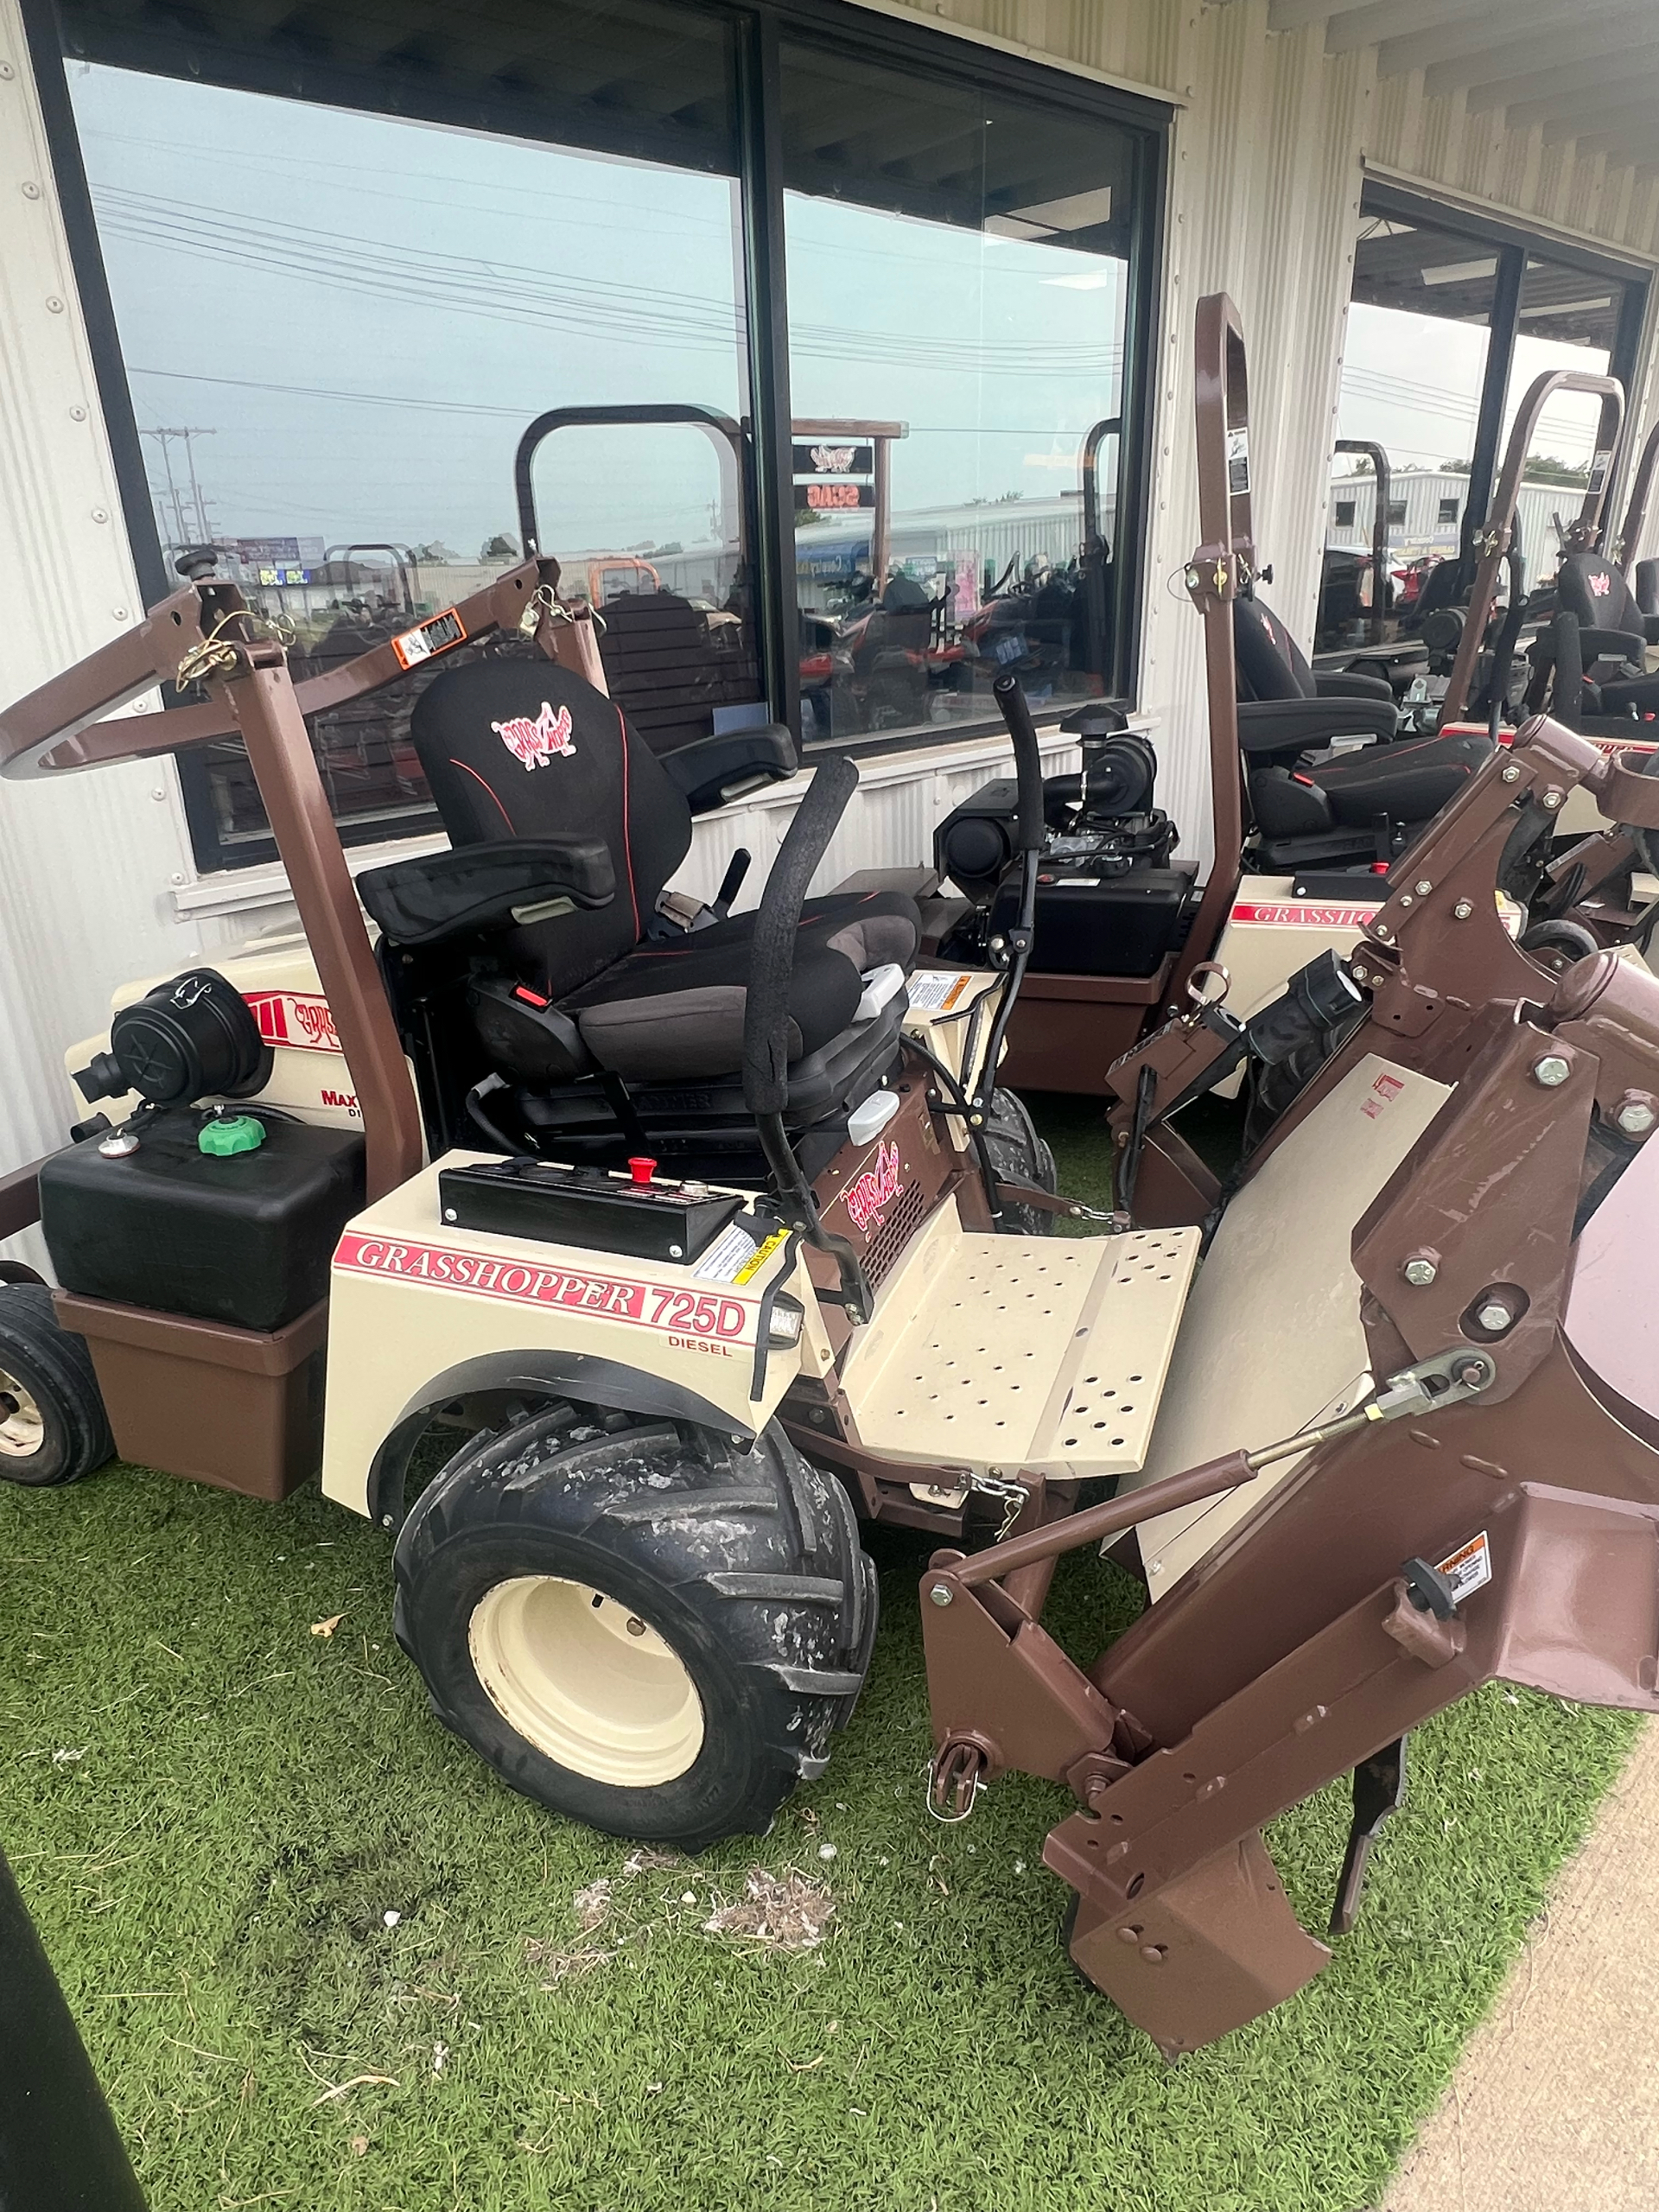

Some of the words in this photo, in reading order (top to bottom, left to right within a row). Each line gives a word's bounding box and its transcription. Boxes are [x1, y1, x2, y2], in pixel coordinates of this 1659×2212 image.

[746, 1240, 777, 1272] CAUTION
[355, 1240, 636, 1315] GRASSHOPPER
[651, 1287, 746, 1337] 725D
[668, 1336, 734, 1357] DIESEL
